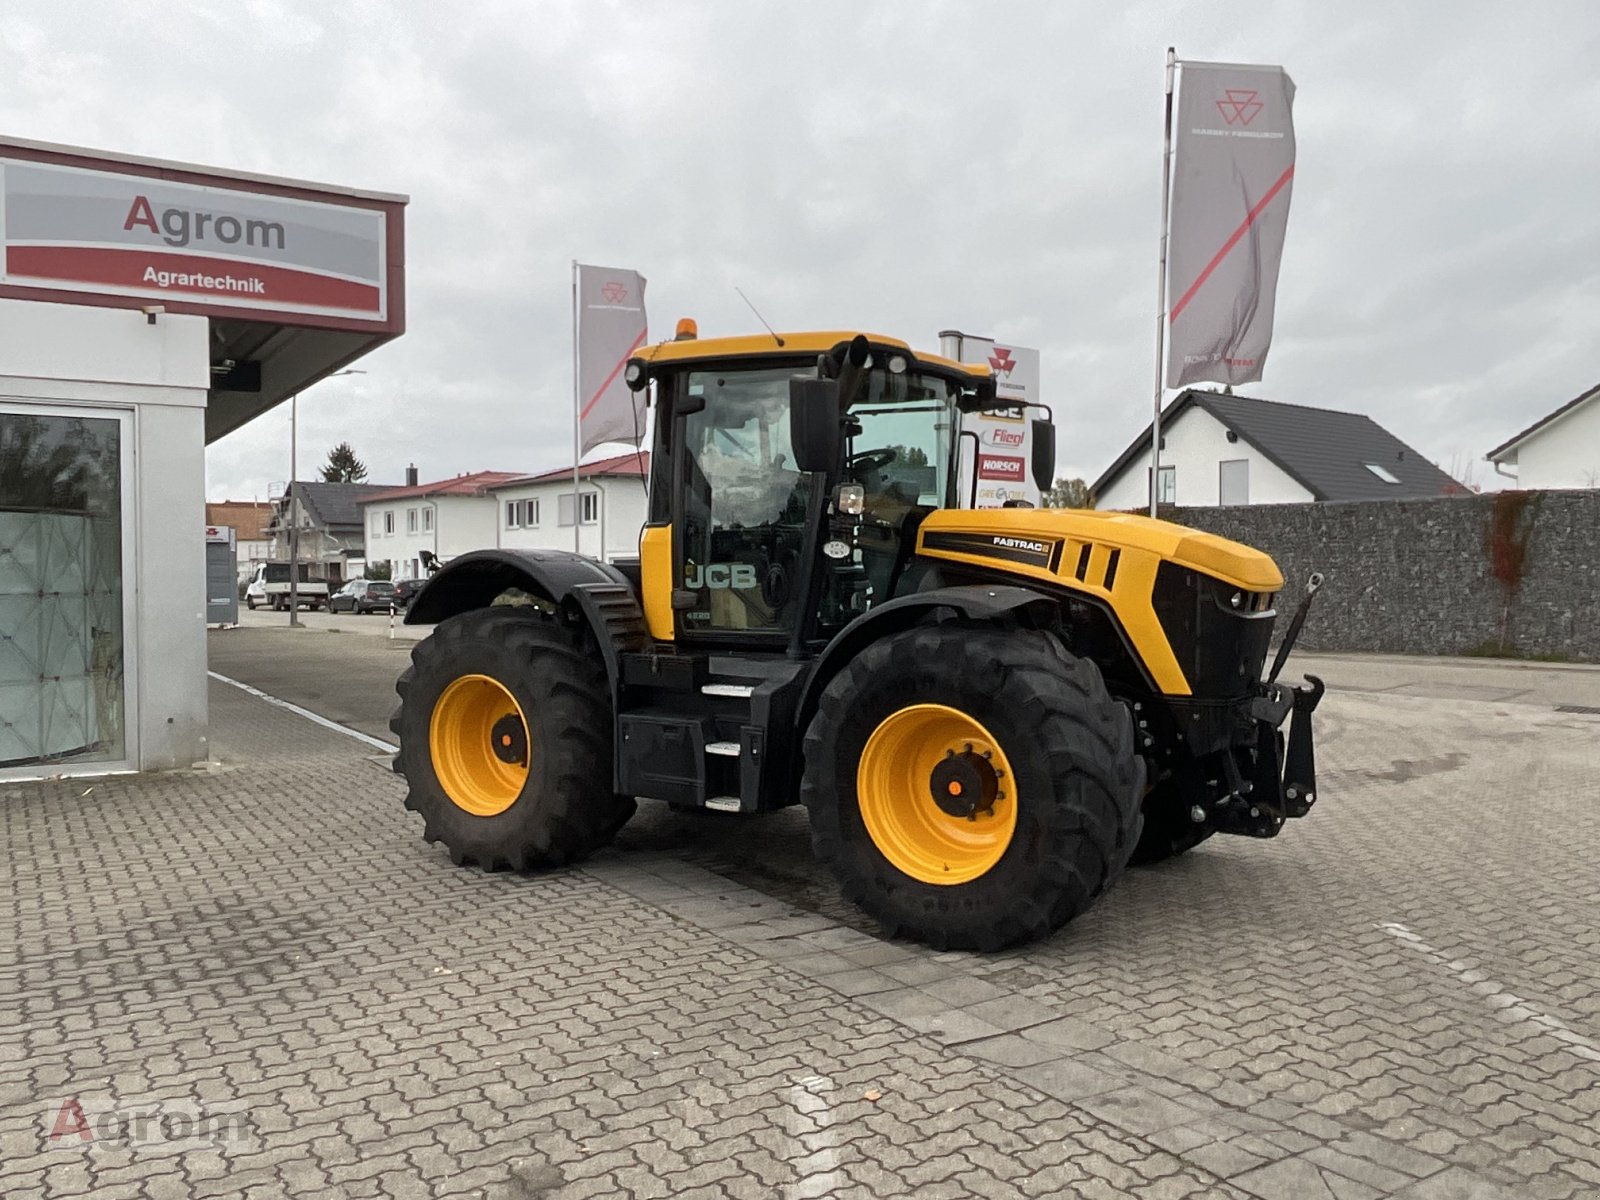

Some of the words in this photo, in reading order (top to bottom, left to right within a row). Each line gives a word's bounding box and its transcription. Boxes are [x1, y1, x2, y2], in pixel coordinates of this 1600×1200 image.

[123, 195, 285, 249] Agrom
[143, 266, 265, 293] Agrartechnik
[992, 428, 1025, 448] Fliegl
[982, 459, 1021, 472] HORSCH
[993, 536, 1043, 552] FASTRAC
[685, 564, 757, 589] JCB
